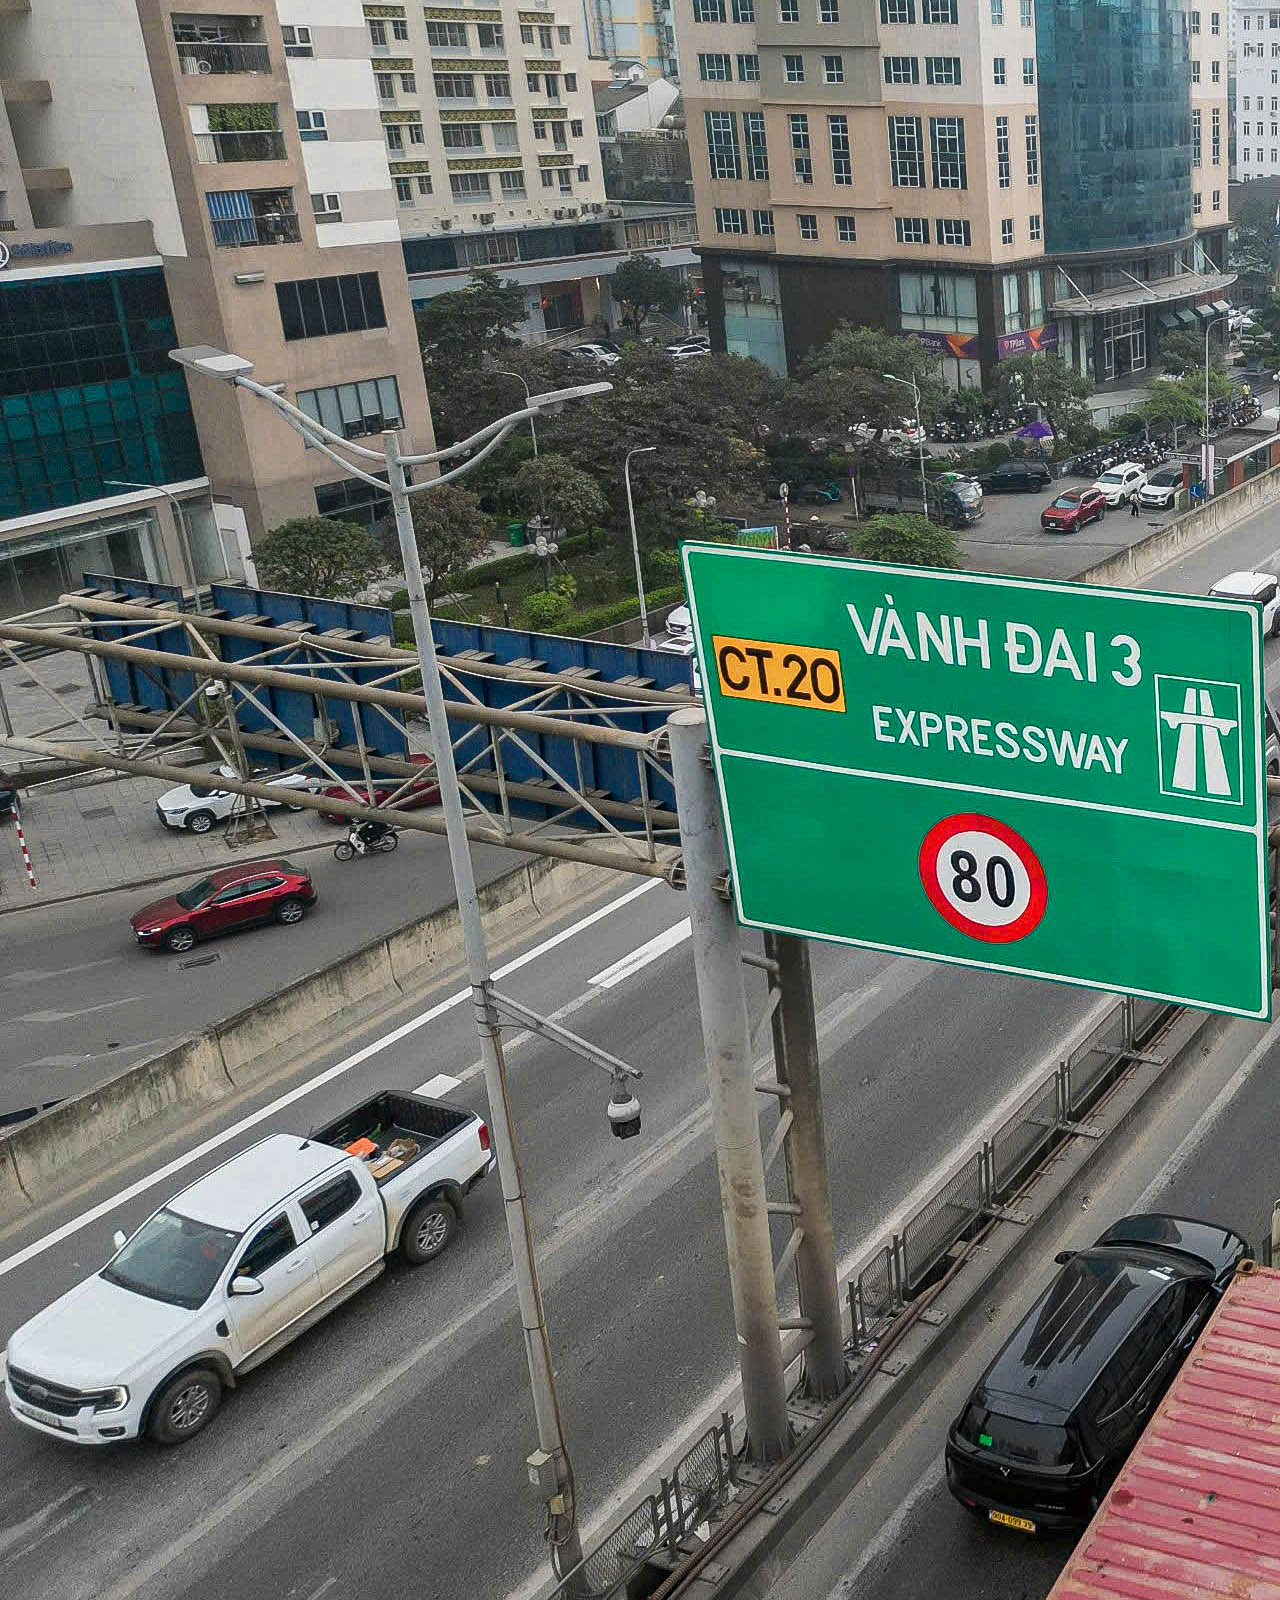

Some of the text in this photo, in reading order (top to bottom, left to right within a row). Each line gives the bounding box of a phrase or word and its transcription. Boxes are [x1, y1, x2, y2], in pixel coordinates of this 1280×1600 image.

[846, 593, 1142, 687] VÀNH ĐAI 3
[719, 645, 842, 704] CT.20
[872, 705, 1129, 774] EXPRESSWAY
[950, 849, 1016, 908] 80
